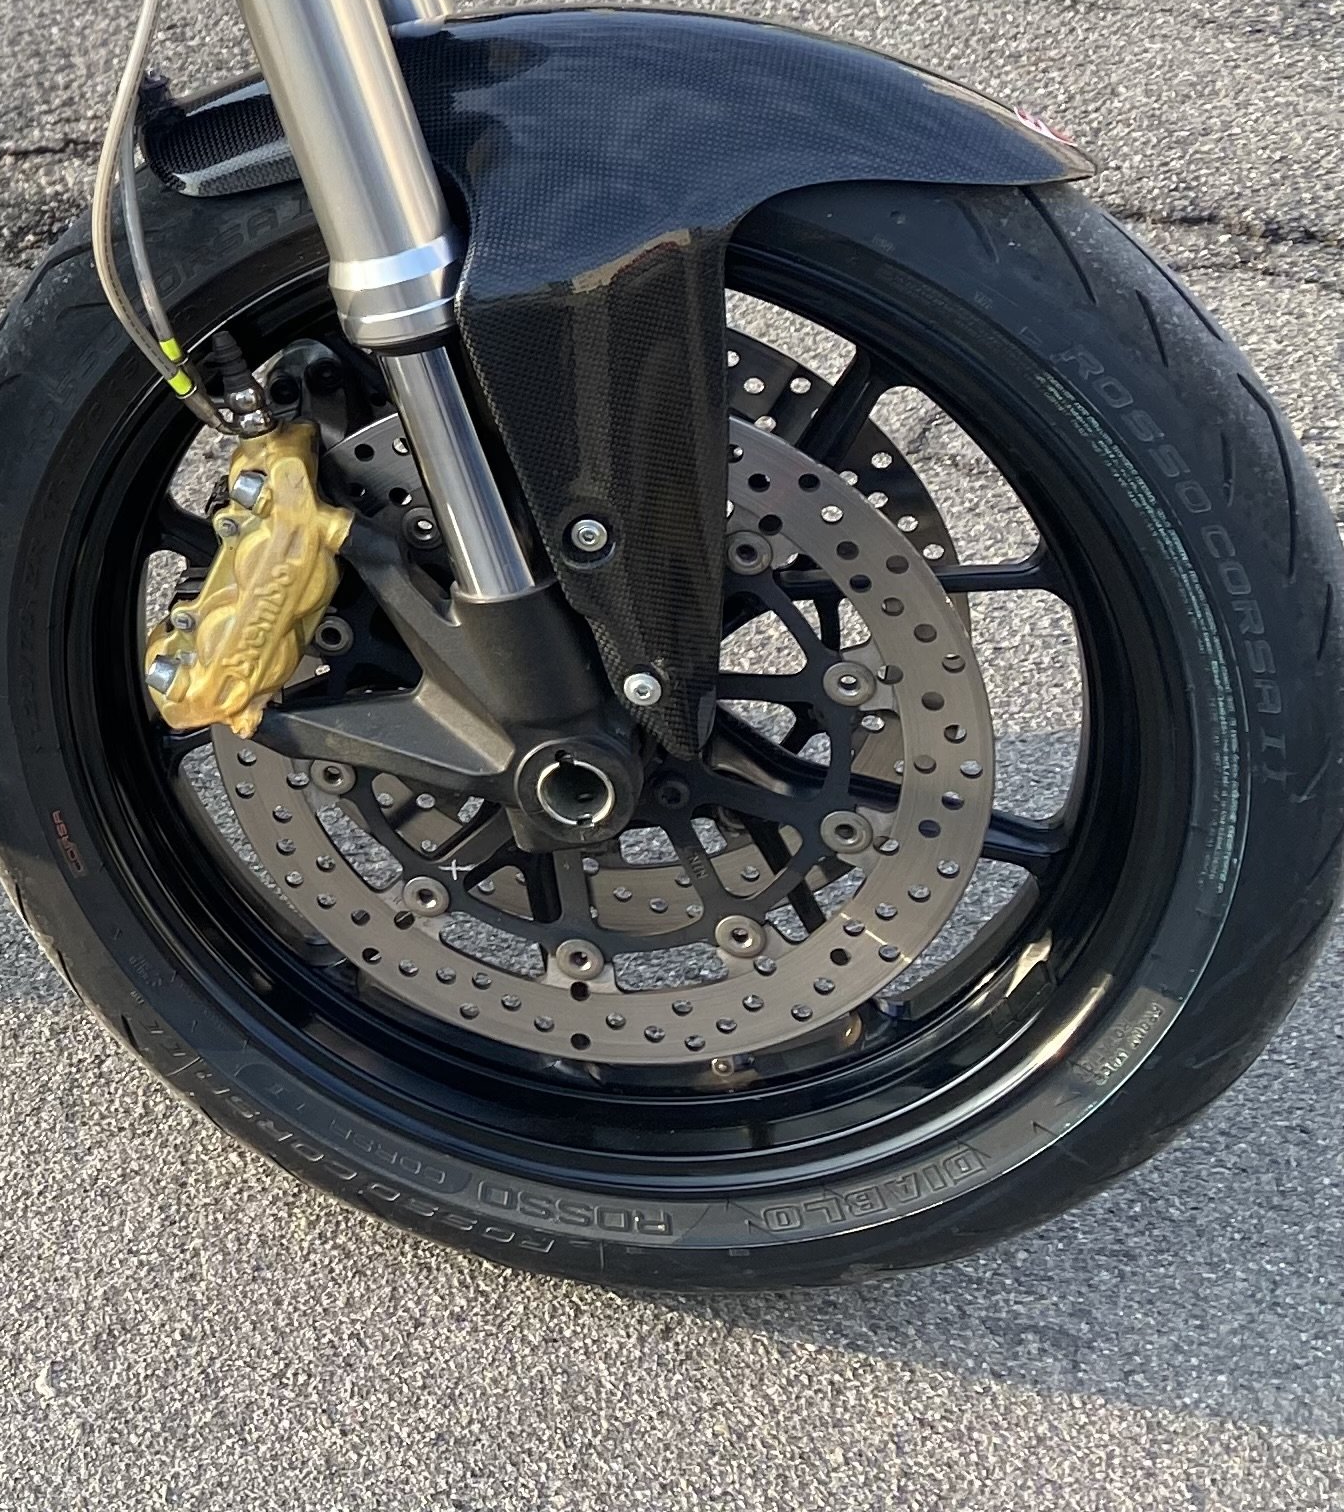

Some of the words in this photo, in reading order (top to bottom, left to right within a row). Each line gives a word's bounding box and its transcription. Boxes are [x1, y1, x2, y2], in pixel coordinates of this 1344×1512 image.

[1055, 345, 1211, 515] ROSSO
[1201, 525, 1283, 716] CORSA
[220, 563, 293, 680] brembo
[478, 1181, 673, 1235] ROSSO
[760, 1148, 986, 1232] DIABLO
